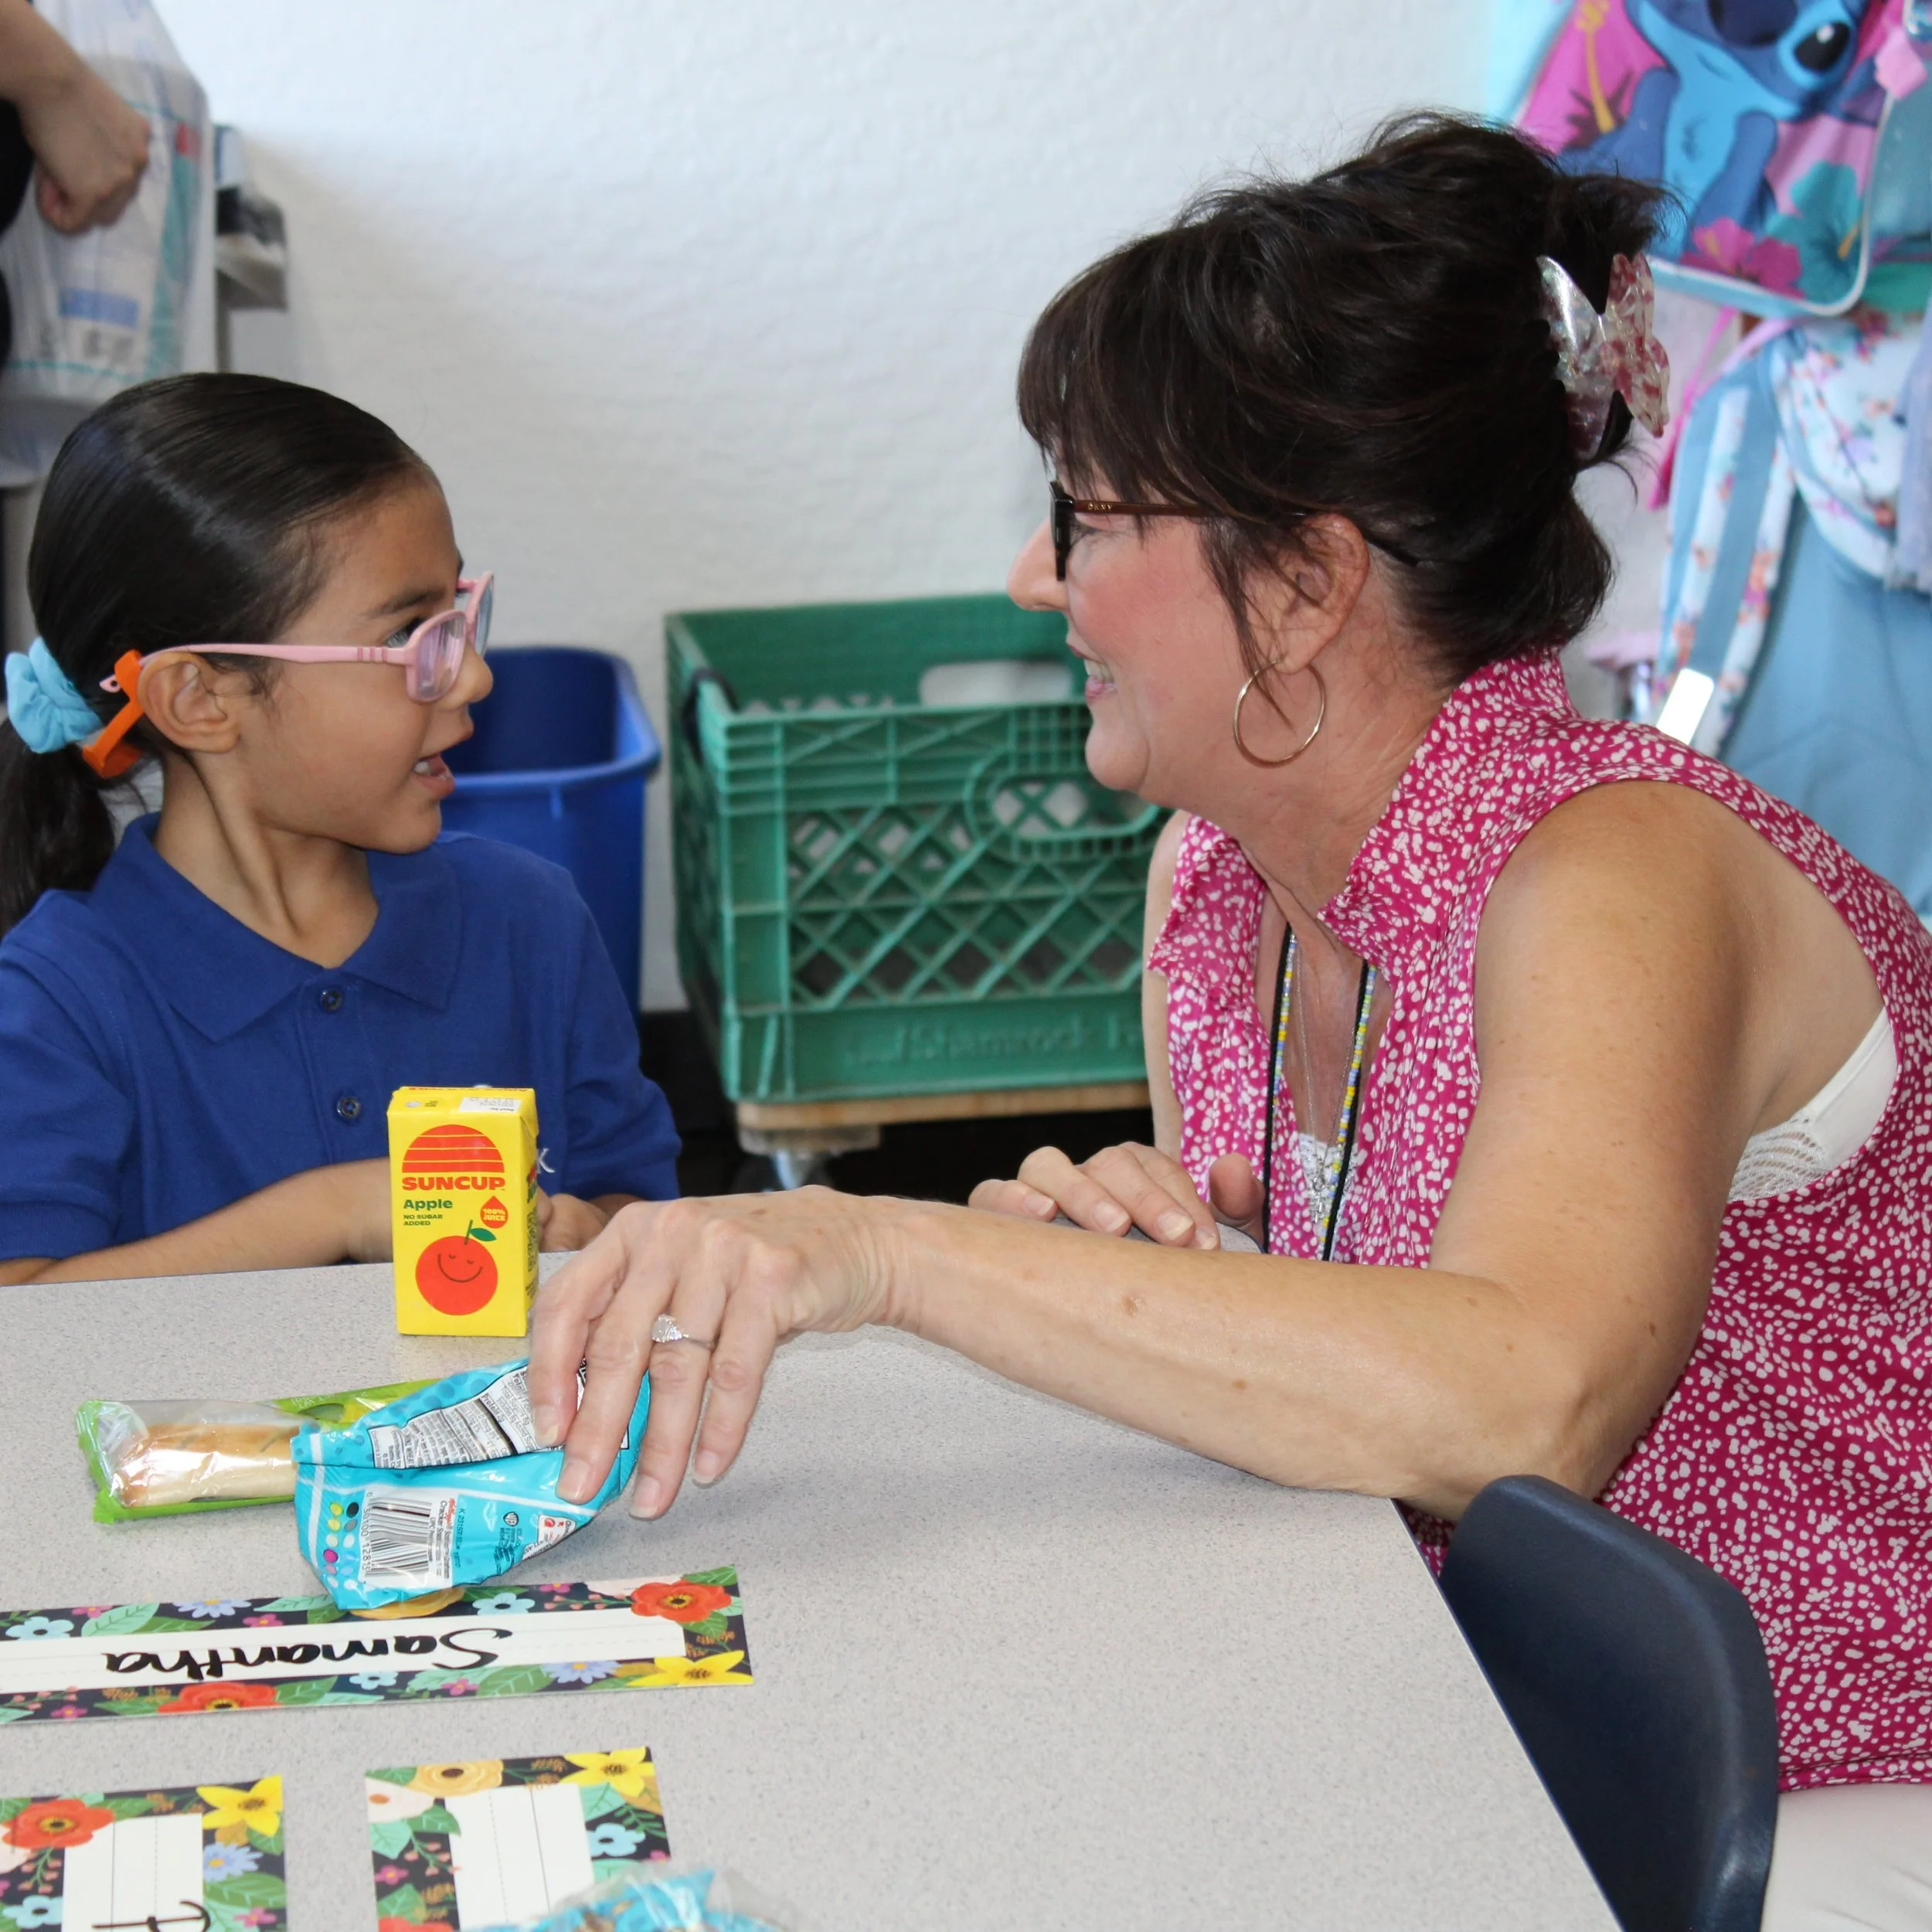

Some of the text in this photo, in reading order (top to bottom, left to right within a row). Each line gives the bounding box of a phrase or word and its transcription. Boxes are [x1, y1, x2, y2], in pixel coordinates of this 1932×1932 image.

[1087, 503, 1113, 512] DKNY
[402, 1176, 505, 1191] SUNCUP
[403, 1199, 453, 1211] Apple
[100, 1628, 512, 1681] Samantha
